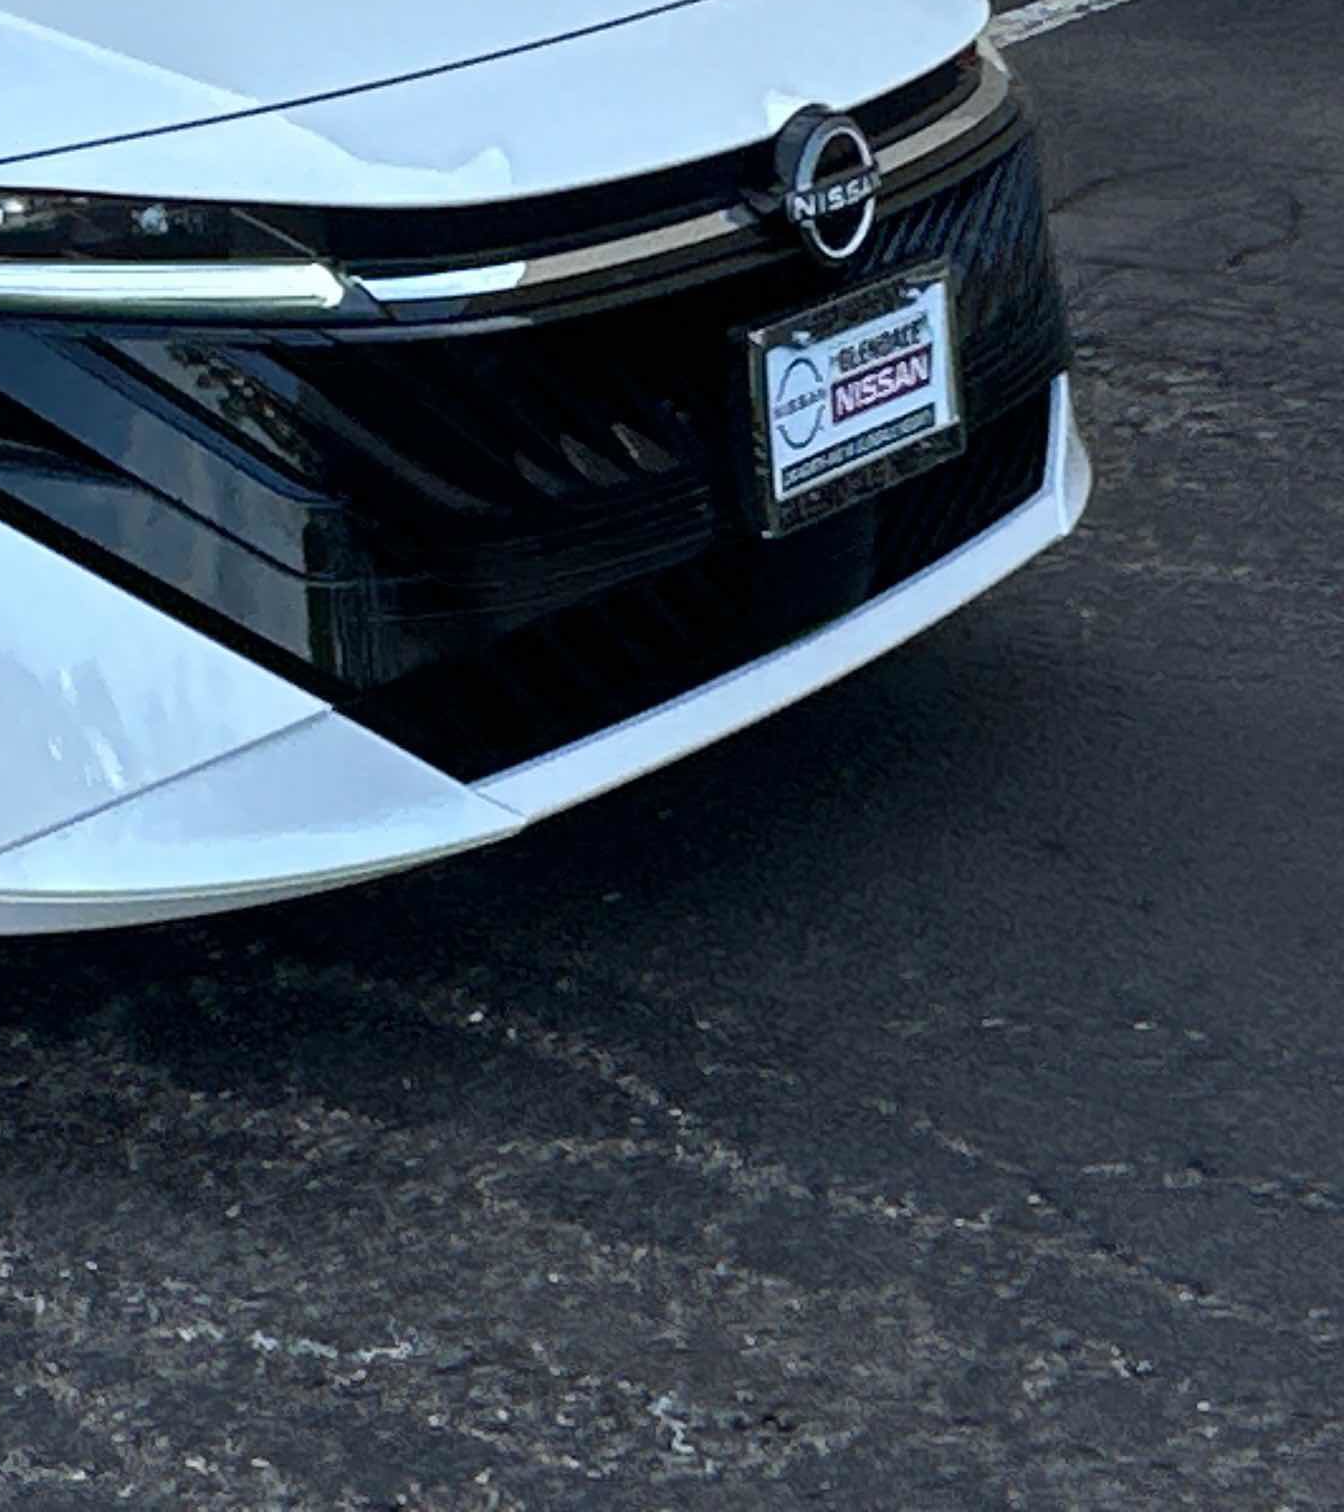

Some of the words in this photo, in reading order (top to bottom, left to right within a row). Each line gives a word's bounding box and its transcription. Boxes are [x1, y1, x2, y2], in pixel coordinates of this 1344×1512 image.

[793, 172, 881, 221] NISSAN
[773, 388, 826, 419] NISSAN
[834, 354, 929, 418] NISSAN
